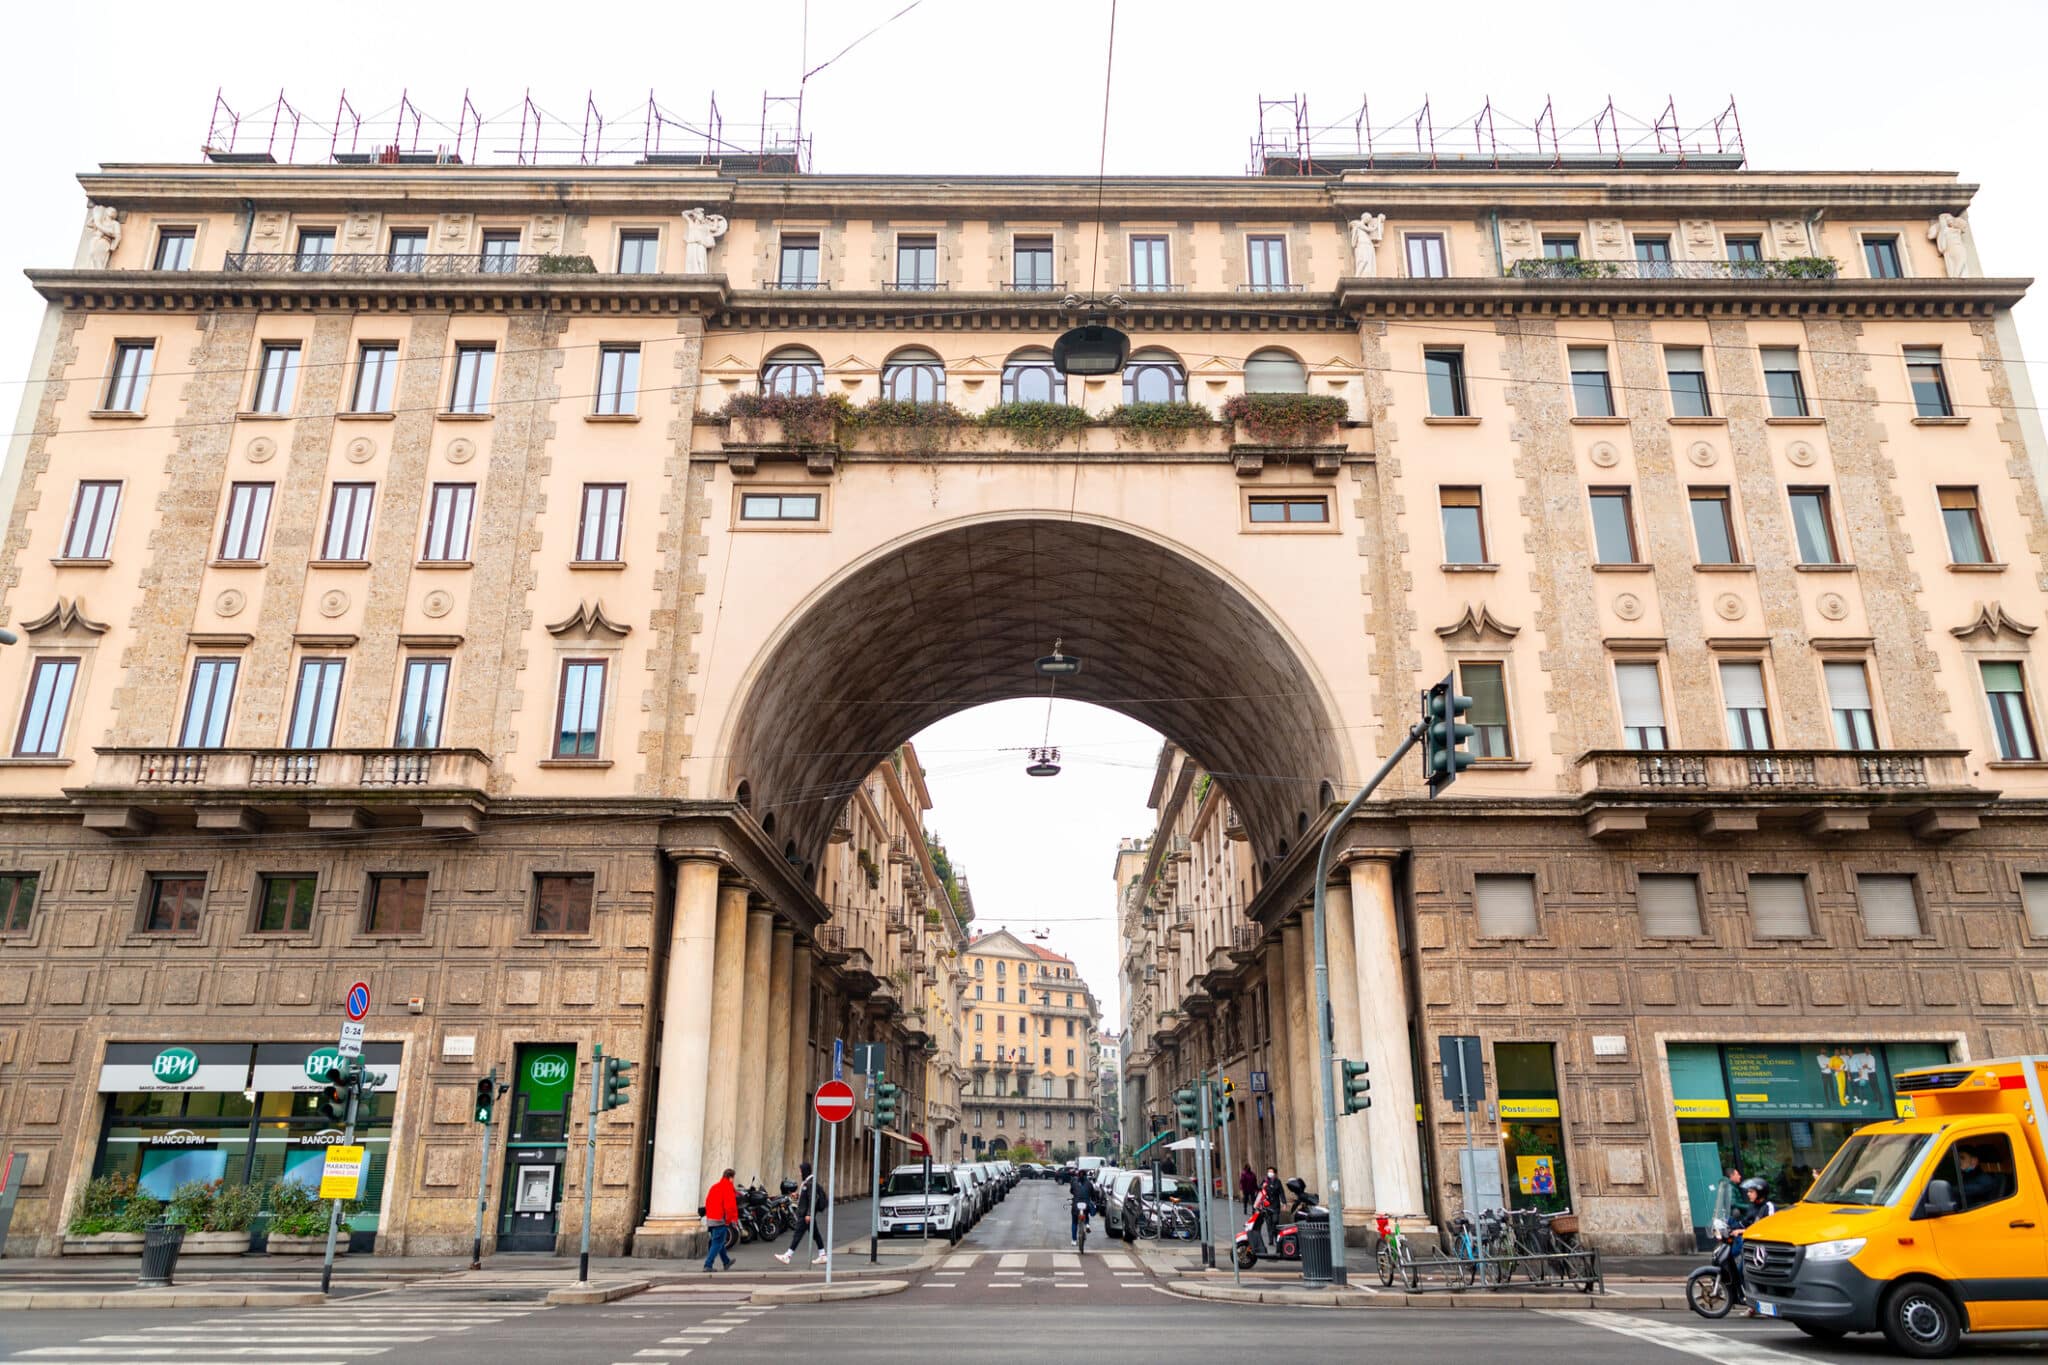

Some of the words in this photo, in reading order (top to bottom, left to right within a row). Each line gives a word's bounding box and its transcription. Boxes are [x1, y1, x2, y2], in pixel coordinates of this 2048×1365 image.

[153, 1055, 197, 1075] BPM
[533, 1062, 568, 1078] BPM
[151, 1135, 185, 1144] BANCO
[185, 1135, 206, 1144] BPM
[302, 1135, 335, 1144] BANCO
